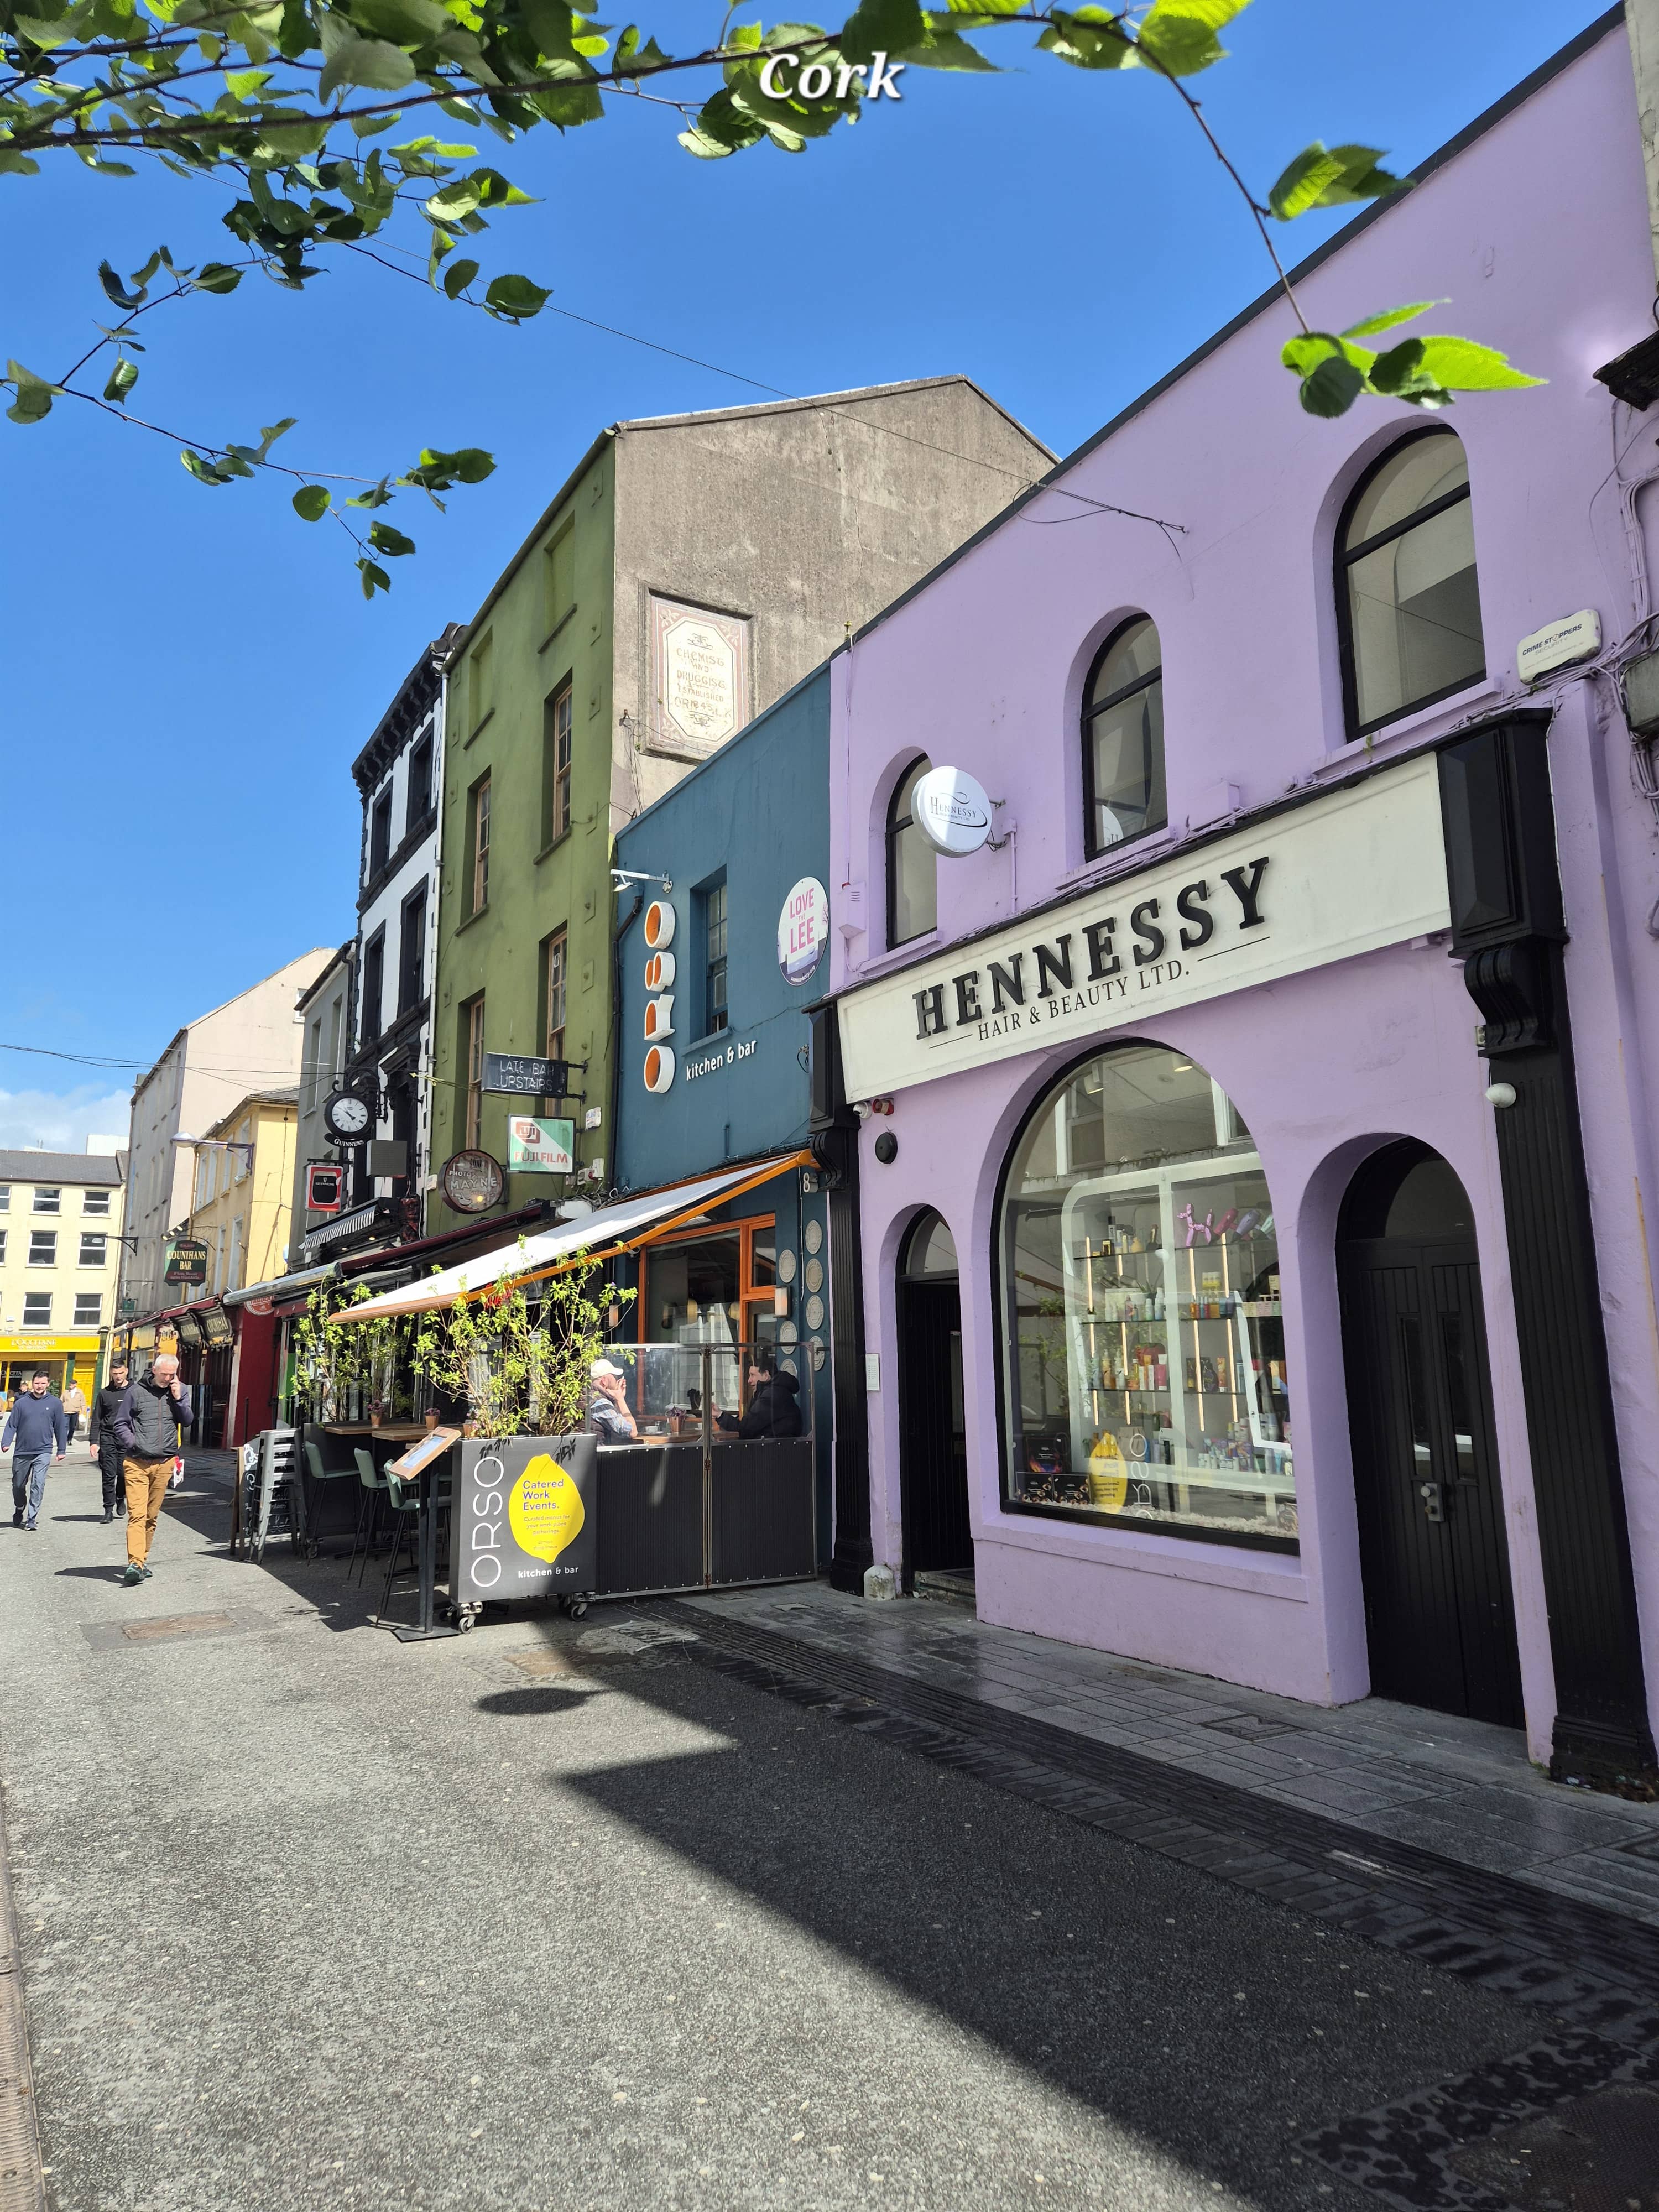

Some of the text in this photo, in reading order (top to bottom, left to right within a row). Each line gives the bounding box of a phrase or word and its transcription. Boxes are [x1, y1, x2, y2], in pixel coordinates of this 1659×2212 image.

[1522, 641, 1543, 656] CRIME
[1544, 624, 1583, 645] STOPPERS
[930, 796, 977, 818] HENNESSY
[790, 887, 815, 919] LOVE
[790, 916, 815, 954] LEE
[912, 856, 1270, 1040] HENNESSY
[978, 959, 1190, 1041] HAIR & BEAUTY LTD.
[500, 1060, 554, 1076] LATE BAR
[686, 1040, 757, 1081] kitchen & bar
[500, 1074, 553, 1091] UPSTAIRS
[334, 1138, 364, 1146] GUINNESS
[450, 1177, 497, 1190] MAYNE
[167, 1250, 206, 1260] COUNIHANS
[179, 1261, 192, 1270] BAR
[523, 1478, 564, 1489] Catered
[523, 1490, 550, 1500] Work
[523, 1501, 560, 1511] Events.
[471, 1457, 504, 1588] ORSO
[518, 1566, 579, 1578] kitchen & bar
